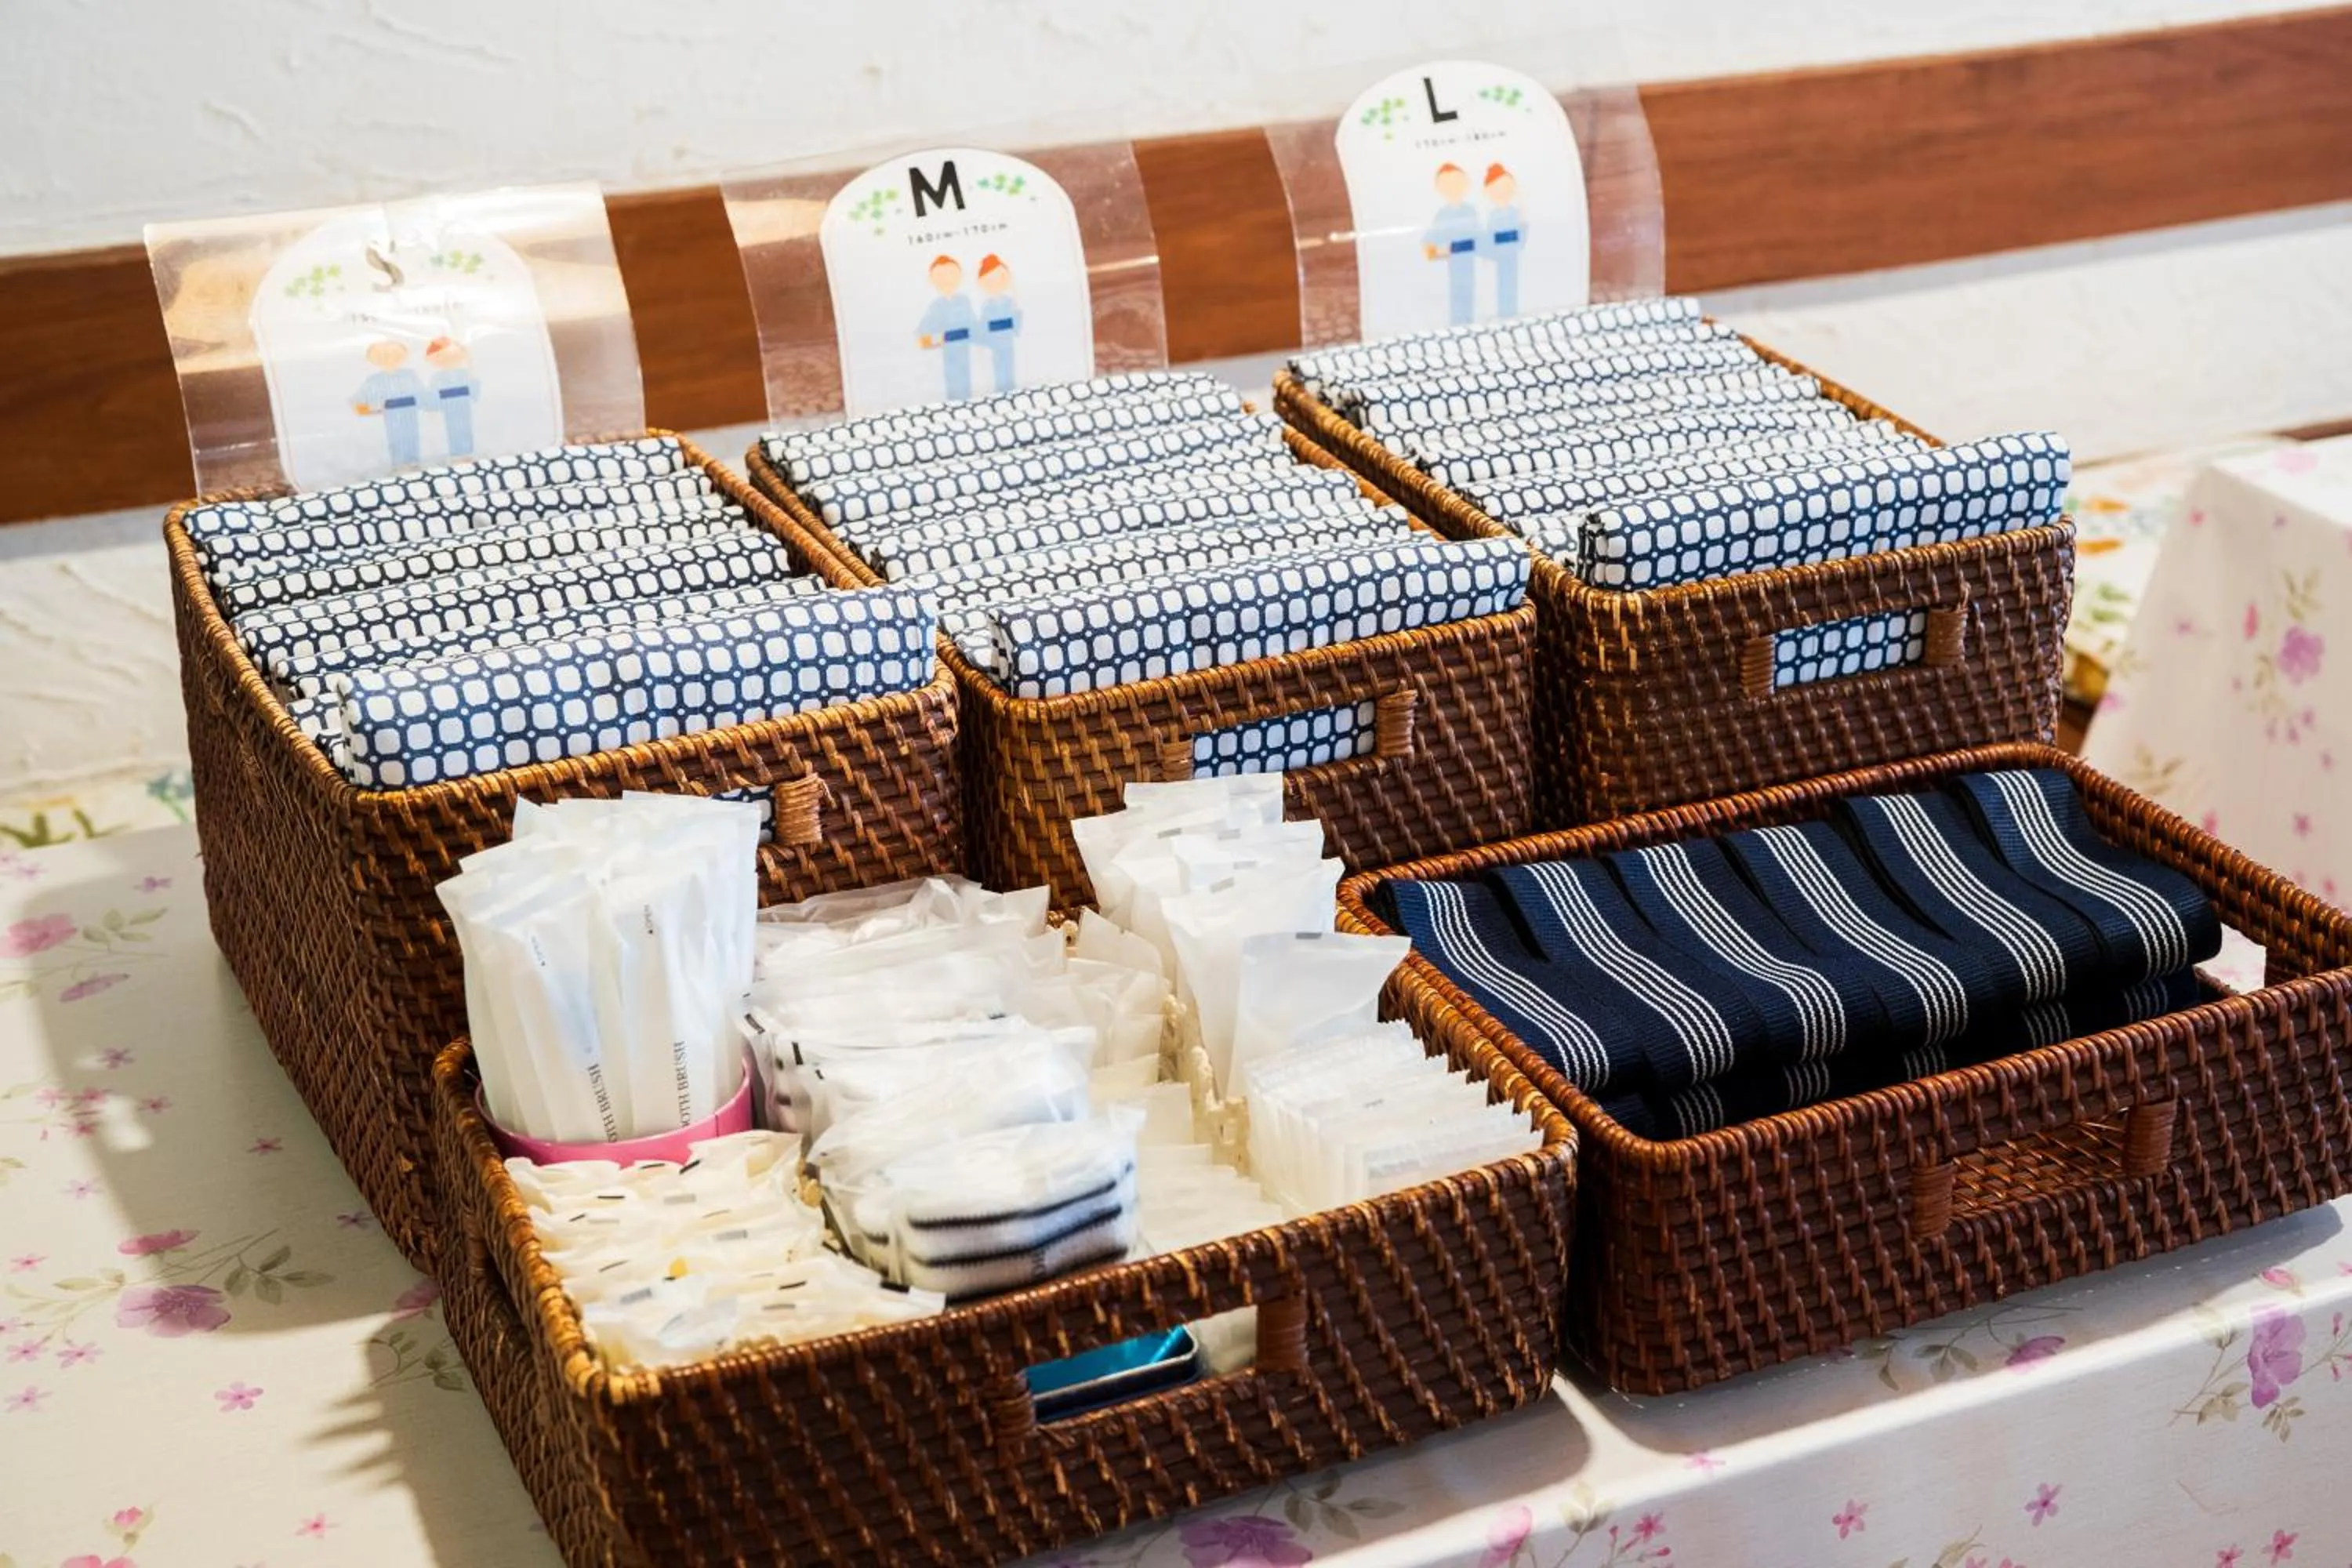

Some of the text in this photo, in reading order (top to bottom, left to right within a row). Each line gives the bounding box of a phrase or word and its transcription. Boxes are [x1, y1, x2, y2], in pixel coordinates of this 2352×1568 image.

[1423, 77, 1457, 122] L
[909, 161, 966, 217] M
[365, 240, 405, 293] S
[587, 1063, 612, 1112] BRUSH
[673, 1040, 690, 1091] BRUSH
